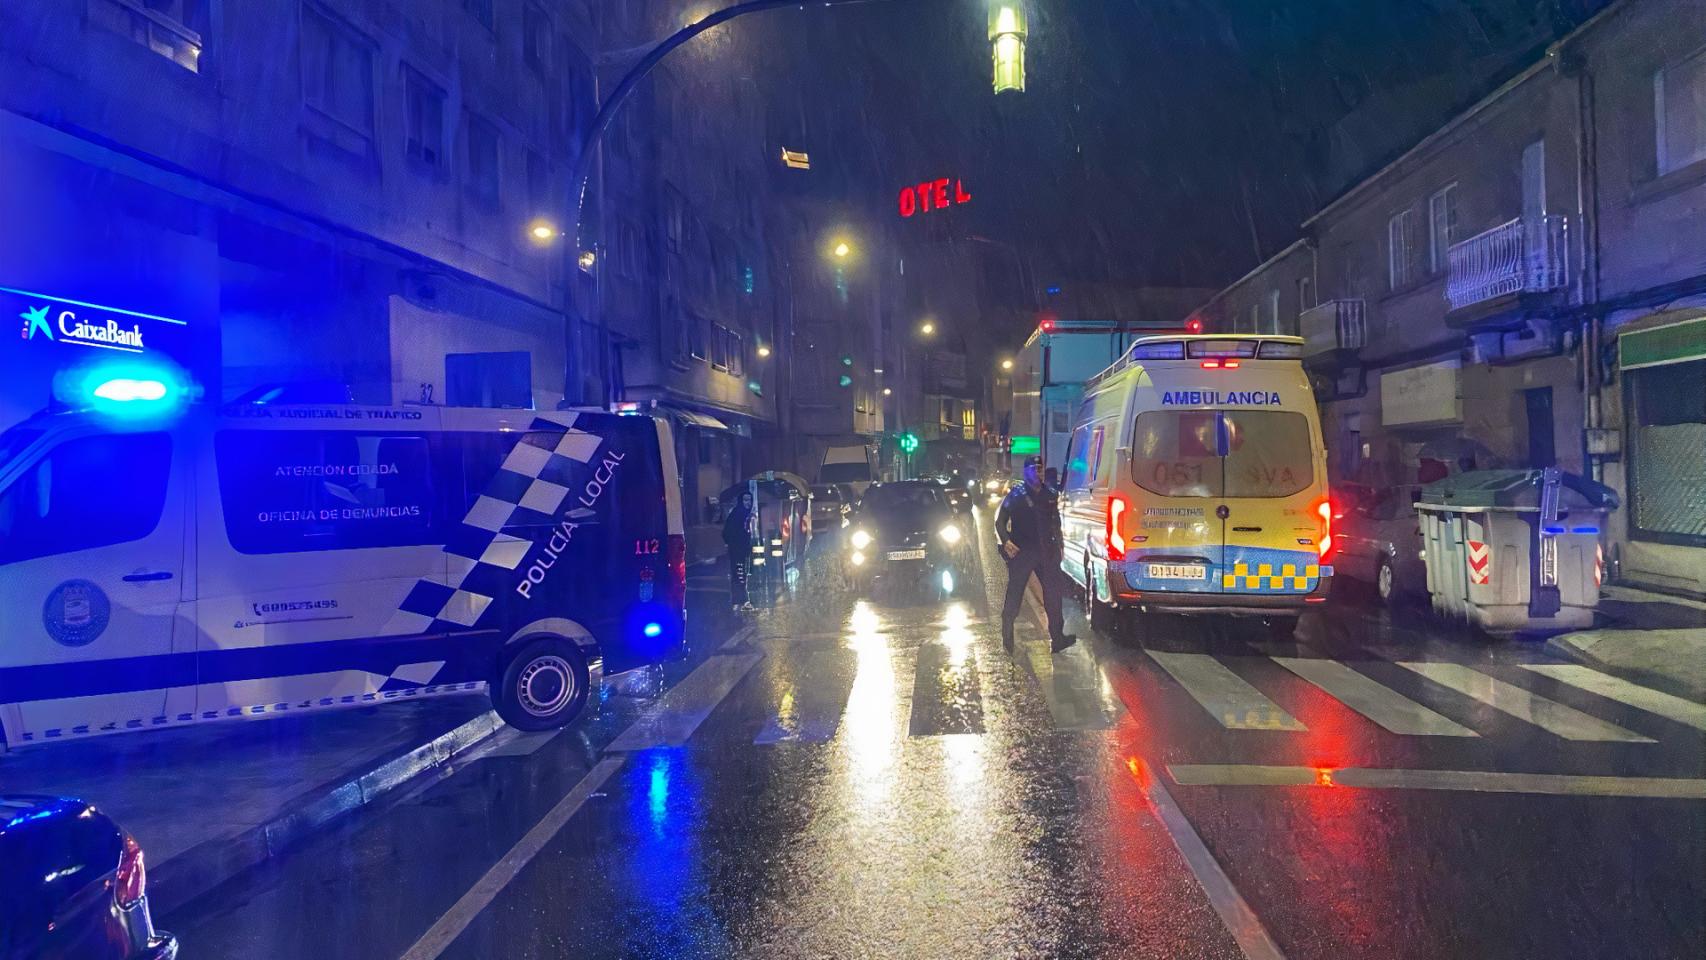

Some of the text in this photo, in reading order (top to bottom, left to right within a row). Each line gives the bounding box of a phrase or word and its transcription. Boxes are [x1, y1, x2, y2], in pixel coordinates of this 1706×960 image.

[899, 177, 971, 217] OTEL
[58, 311, 144, 347] CaixaBank
[1161, 391, 1282, 406] AMBULANCIA
[258, 505, 420, 523] OFICINA DE DENUNCIAS
[516, 450, 625, 600] POLICÍA LOCAL
[635, 538, 660, 555] 112
